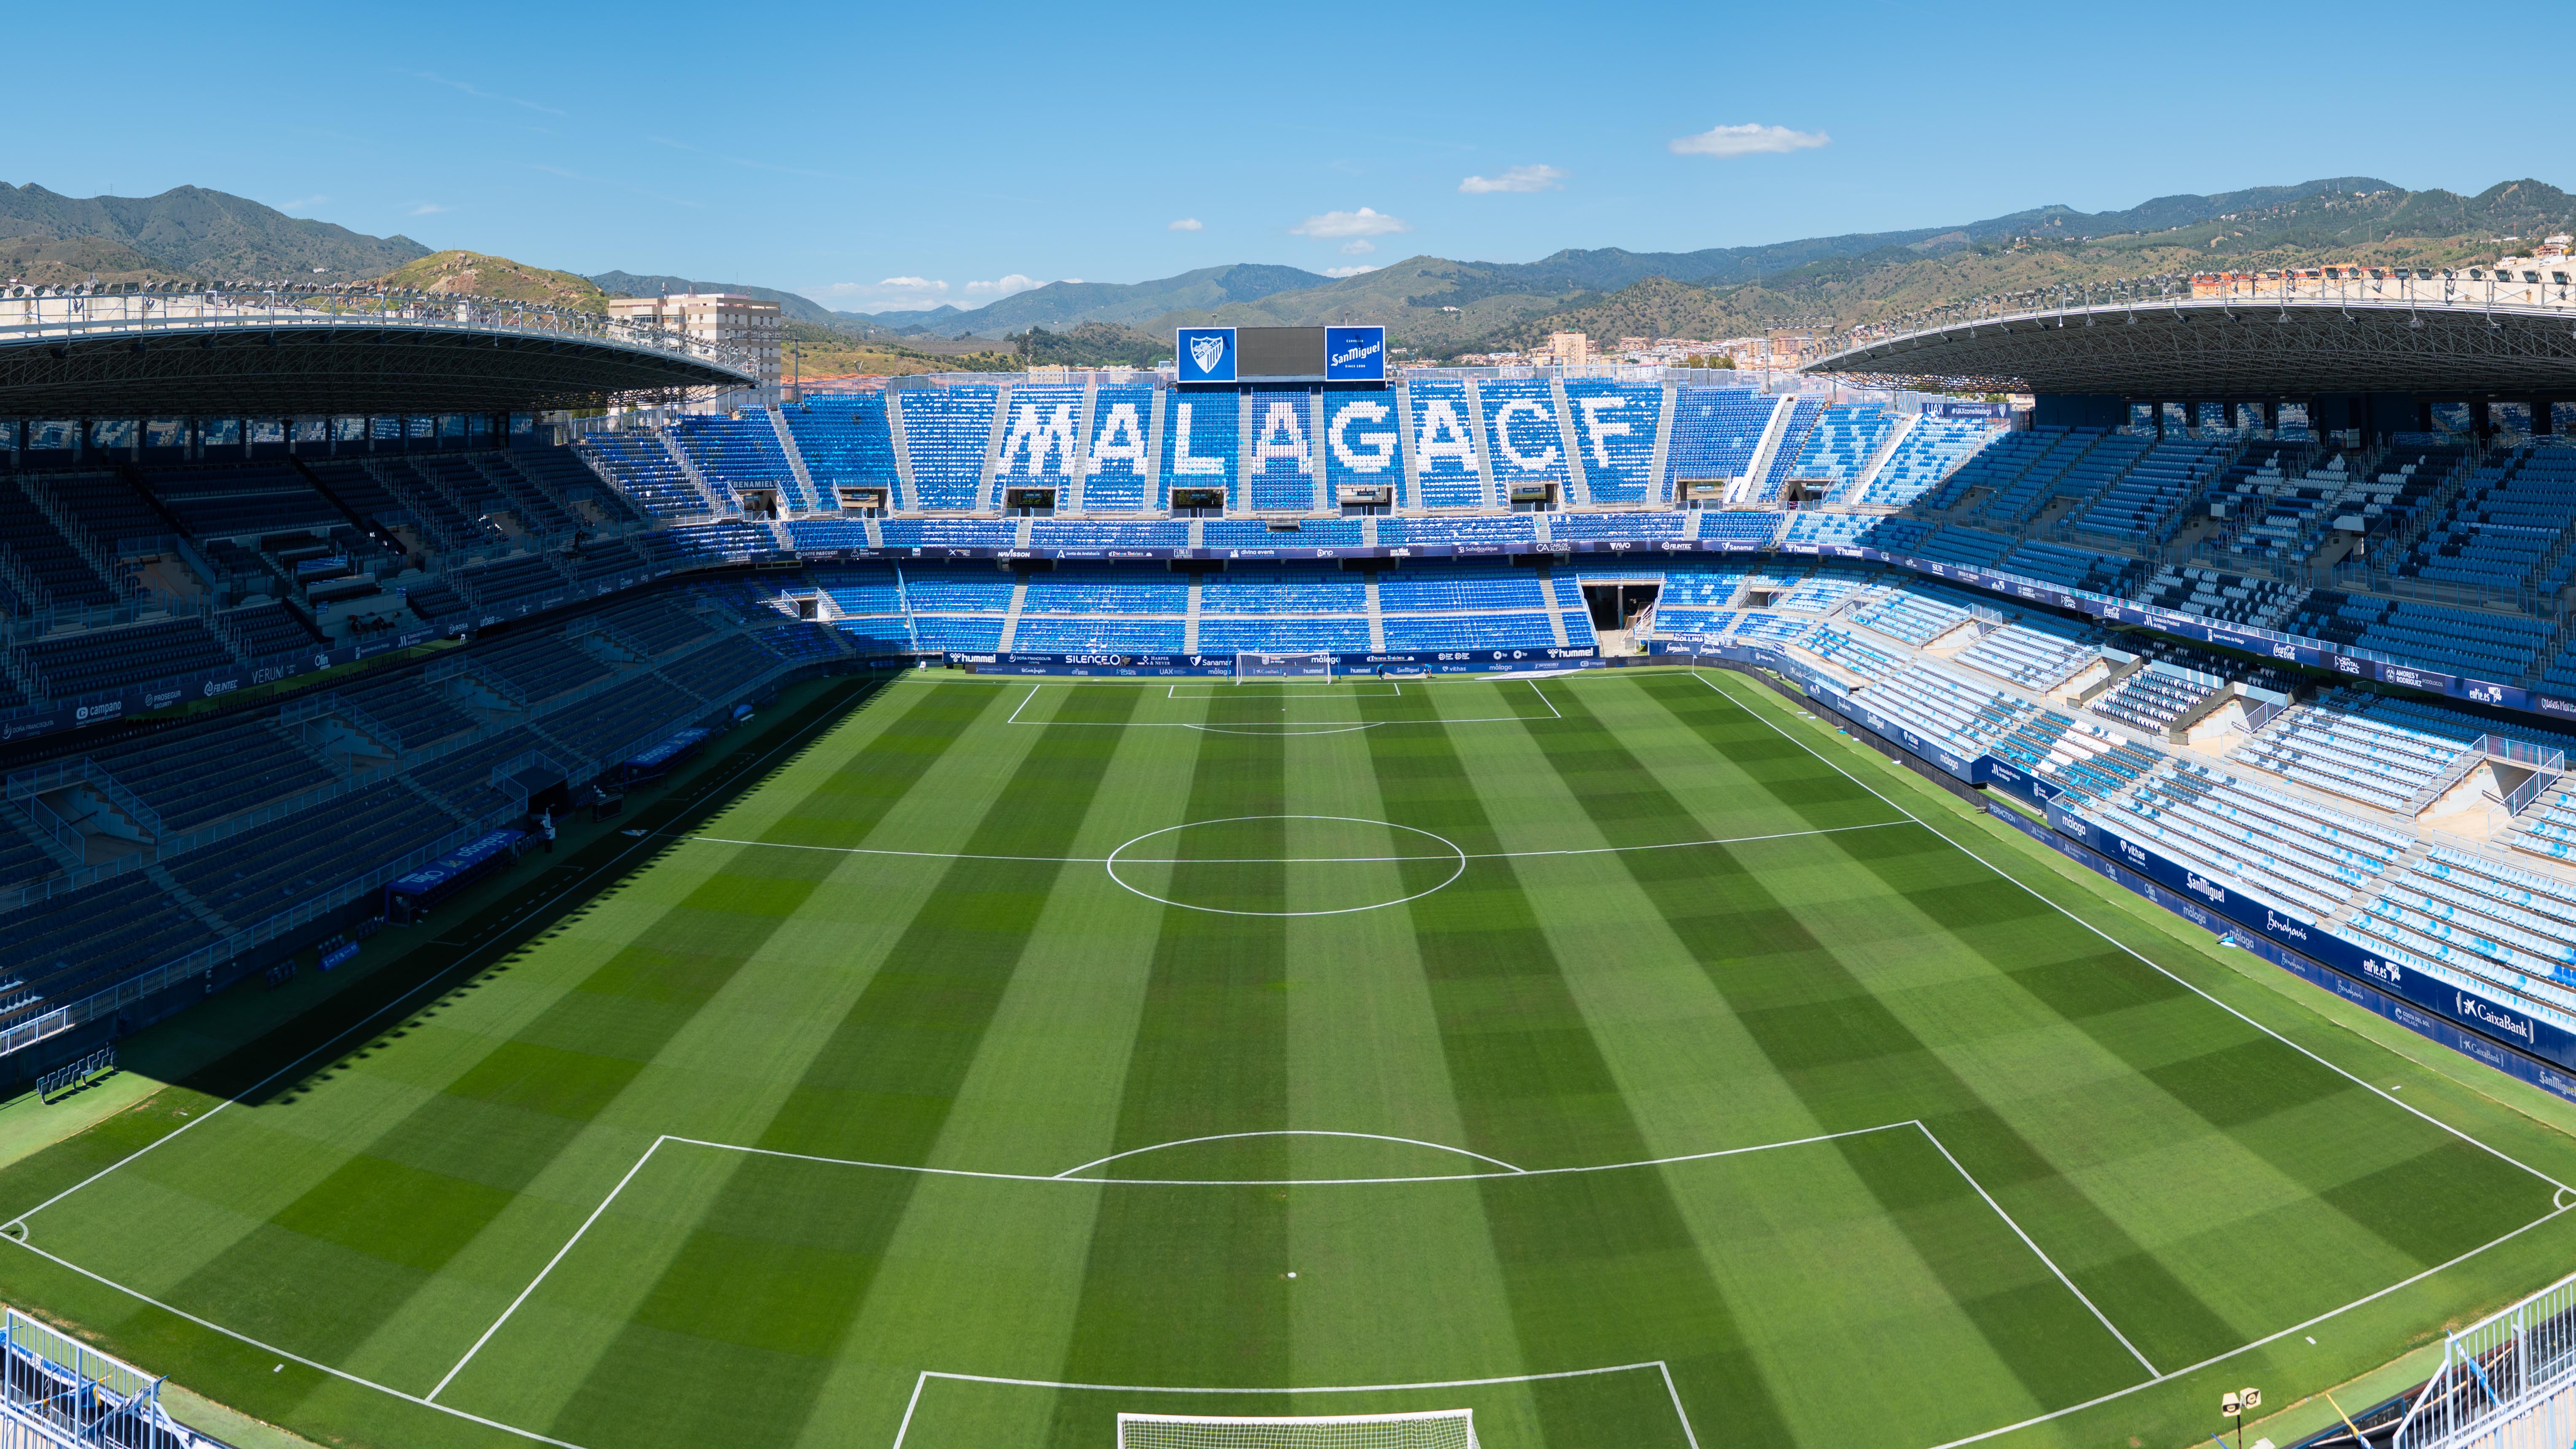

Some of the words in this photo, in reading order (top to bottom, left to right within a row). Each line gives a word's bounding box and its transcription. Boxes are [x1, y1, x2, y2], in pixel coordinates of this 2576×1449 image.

[1331, 341, 1380, 367] SanMiguel
[997, 548, 1030, 558] NAVISSON
[1794, 545, 1819, 553] hummel
[1842, 548, 1863, 557] hummel
[1932, 563, 1943, 573] SUR
[480, 616, 495, 627] urbea
[1559, 647, 1594, 658] hummel
[1665, 643, 1690, 653] famadesa
[1699, 645, 1722, 655] famadesa
[314, 654, 328, 667] Olin
[962, 654, 996, 663] hummel
[2340, 659, 2360, 669] DENTAL
[252, 665, 284, 685] VERUM
[2340, 665, 2360, 674] CLINICS
[2396, 669, 2413, 679] AMORES
[2396, 675, 2422, 687] RODRÍGUEZ
[153, 690, 181, 702] PROSEGUR
[2469, 688, 2490, 702] enPie.es
[90, 701, 122, 717] campano
[153, 700, 173, 710] SECURITY
[2541, 697, 2560, 710] Quesos
[12, 726, 25, 734] DOÑA
[25, 720, 54, 731] FRANCISQUITA
[1908, 734, 1918, 745] vithas
[2127, 844, 2145, 861] vithas
[2106, 863, 2116, 876] Olin
[2144, 883, 2155, 897] Olin
[2186, 871, 2224, 904] SanMiguel
[2364, 958, 2387, 979] enPie.es
[2402, 1011, 2415, 1022] COSTA
[2414, 1016, 2422, 1024] DEL
[2422, 1019, 2430, 1029] SOL
[2477, 1004, 2528, 1038] CaixaBank
[2471, 1043, 2501, 1064] CaixaBank
